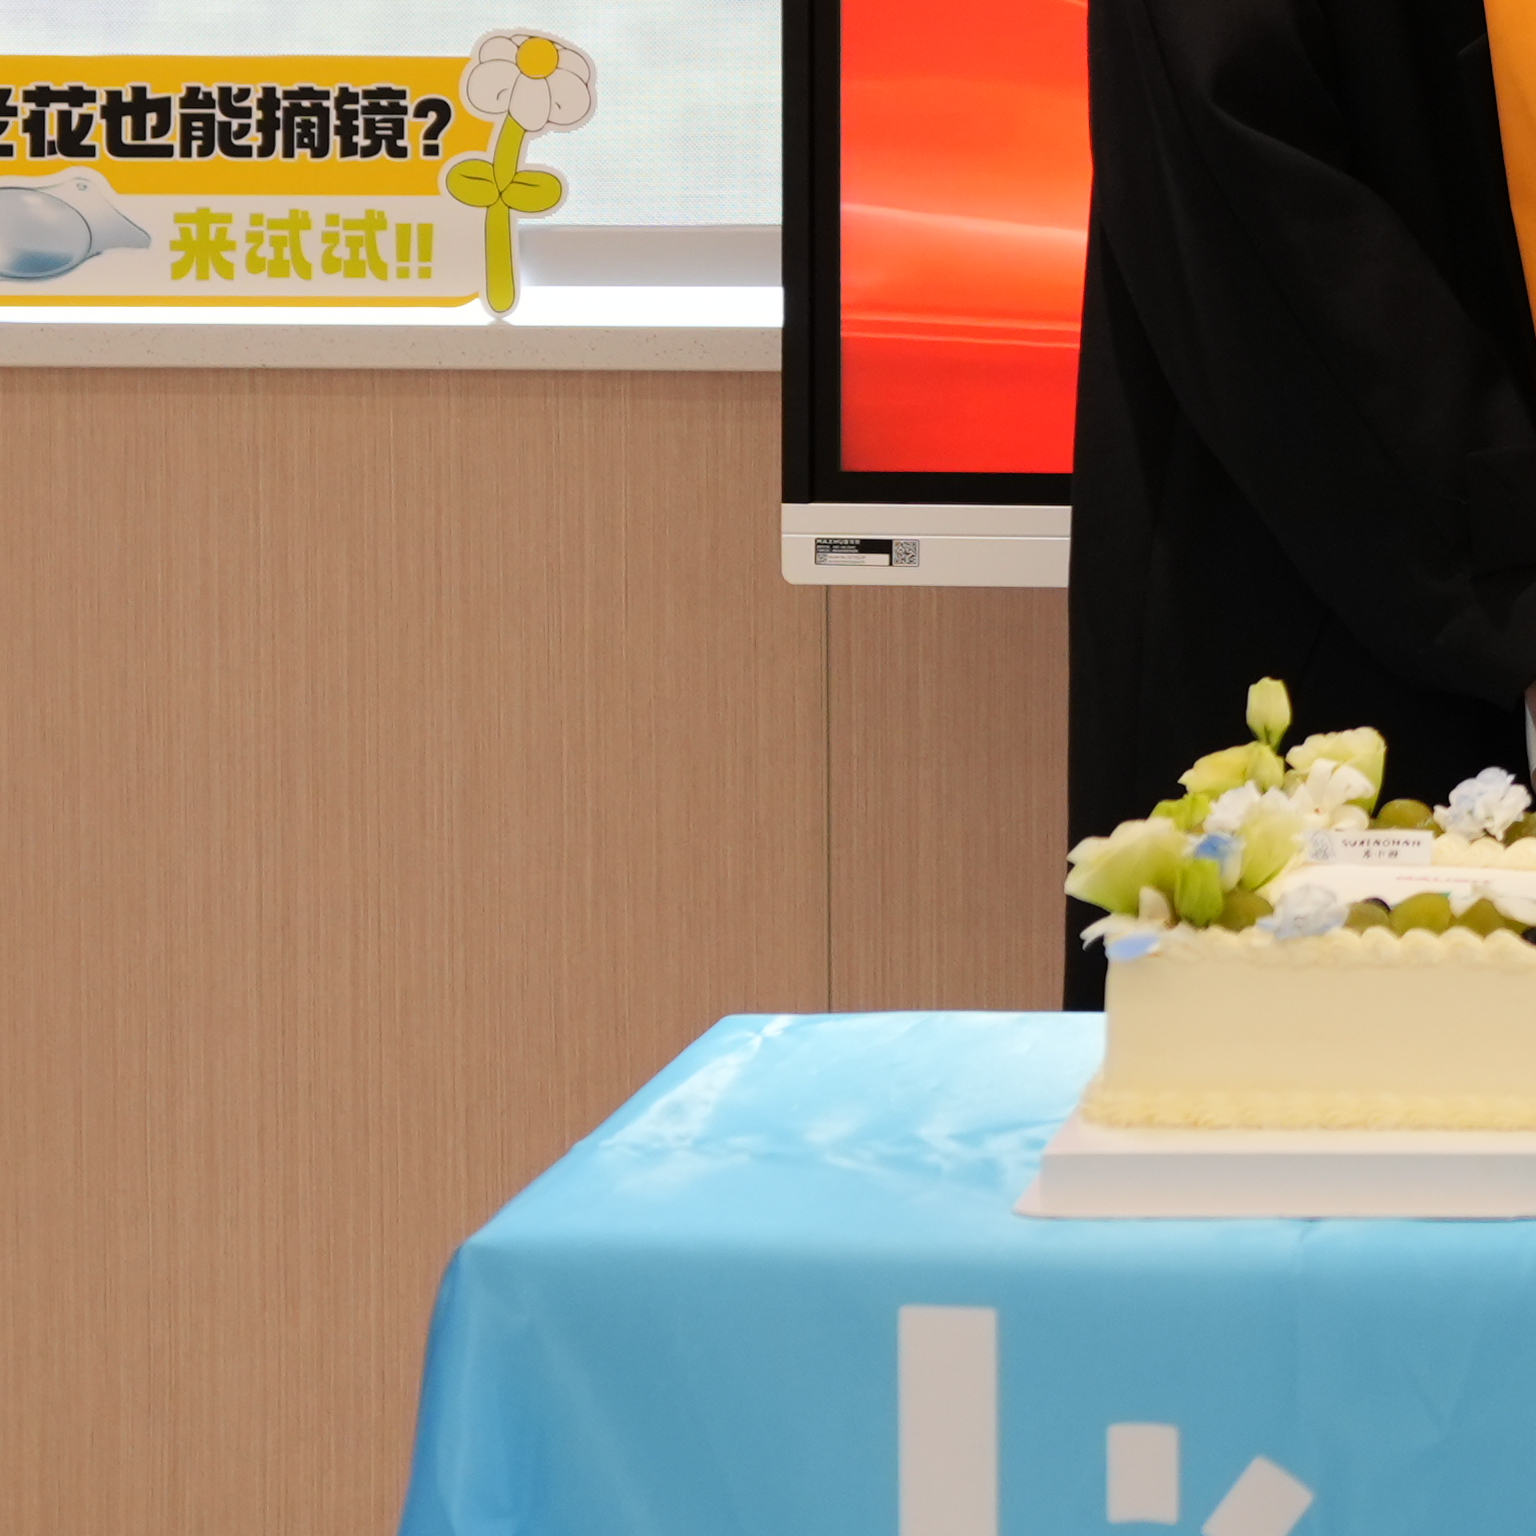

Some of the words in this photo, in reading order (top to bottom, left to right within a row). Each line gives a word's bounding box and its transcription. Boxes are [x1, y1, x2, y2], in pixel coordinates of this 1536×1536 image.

[0, 85, 453, 160] 花也能摘镜?
